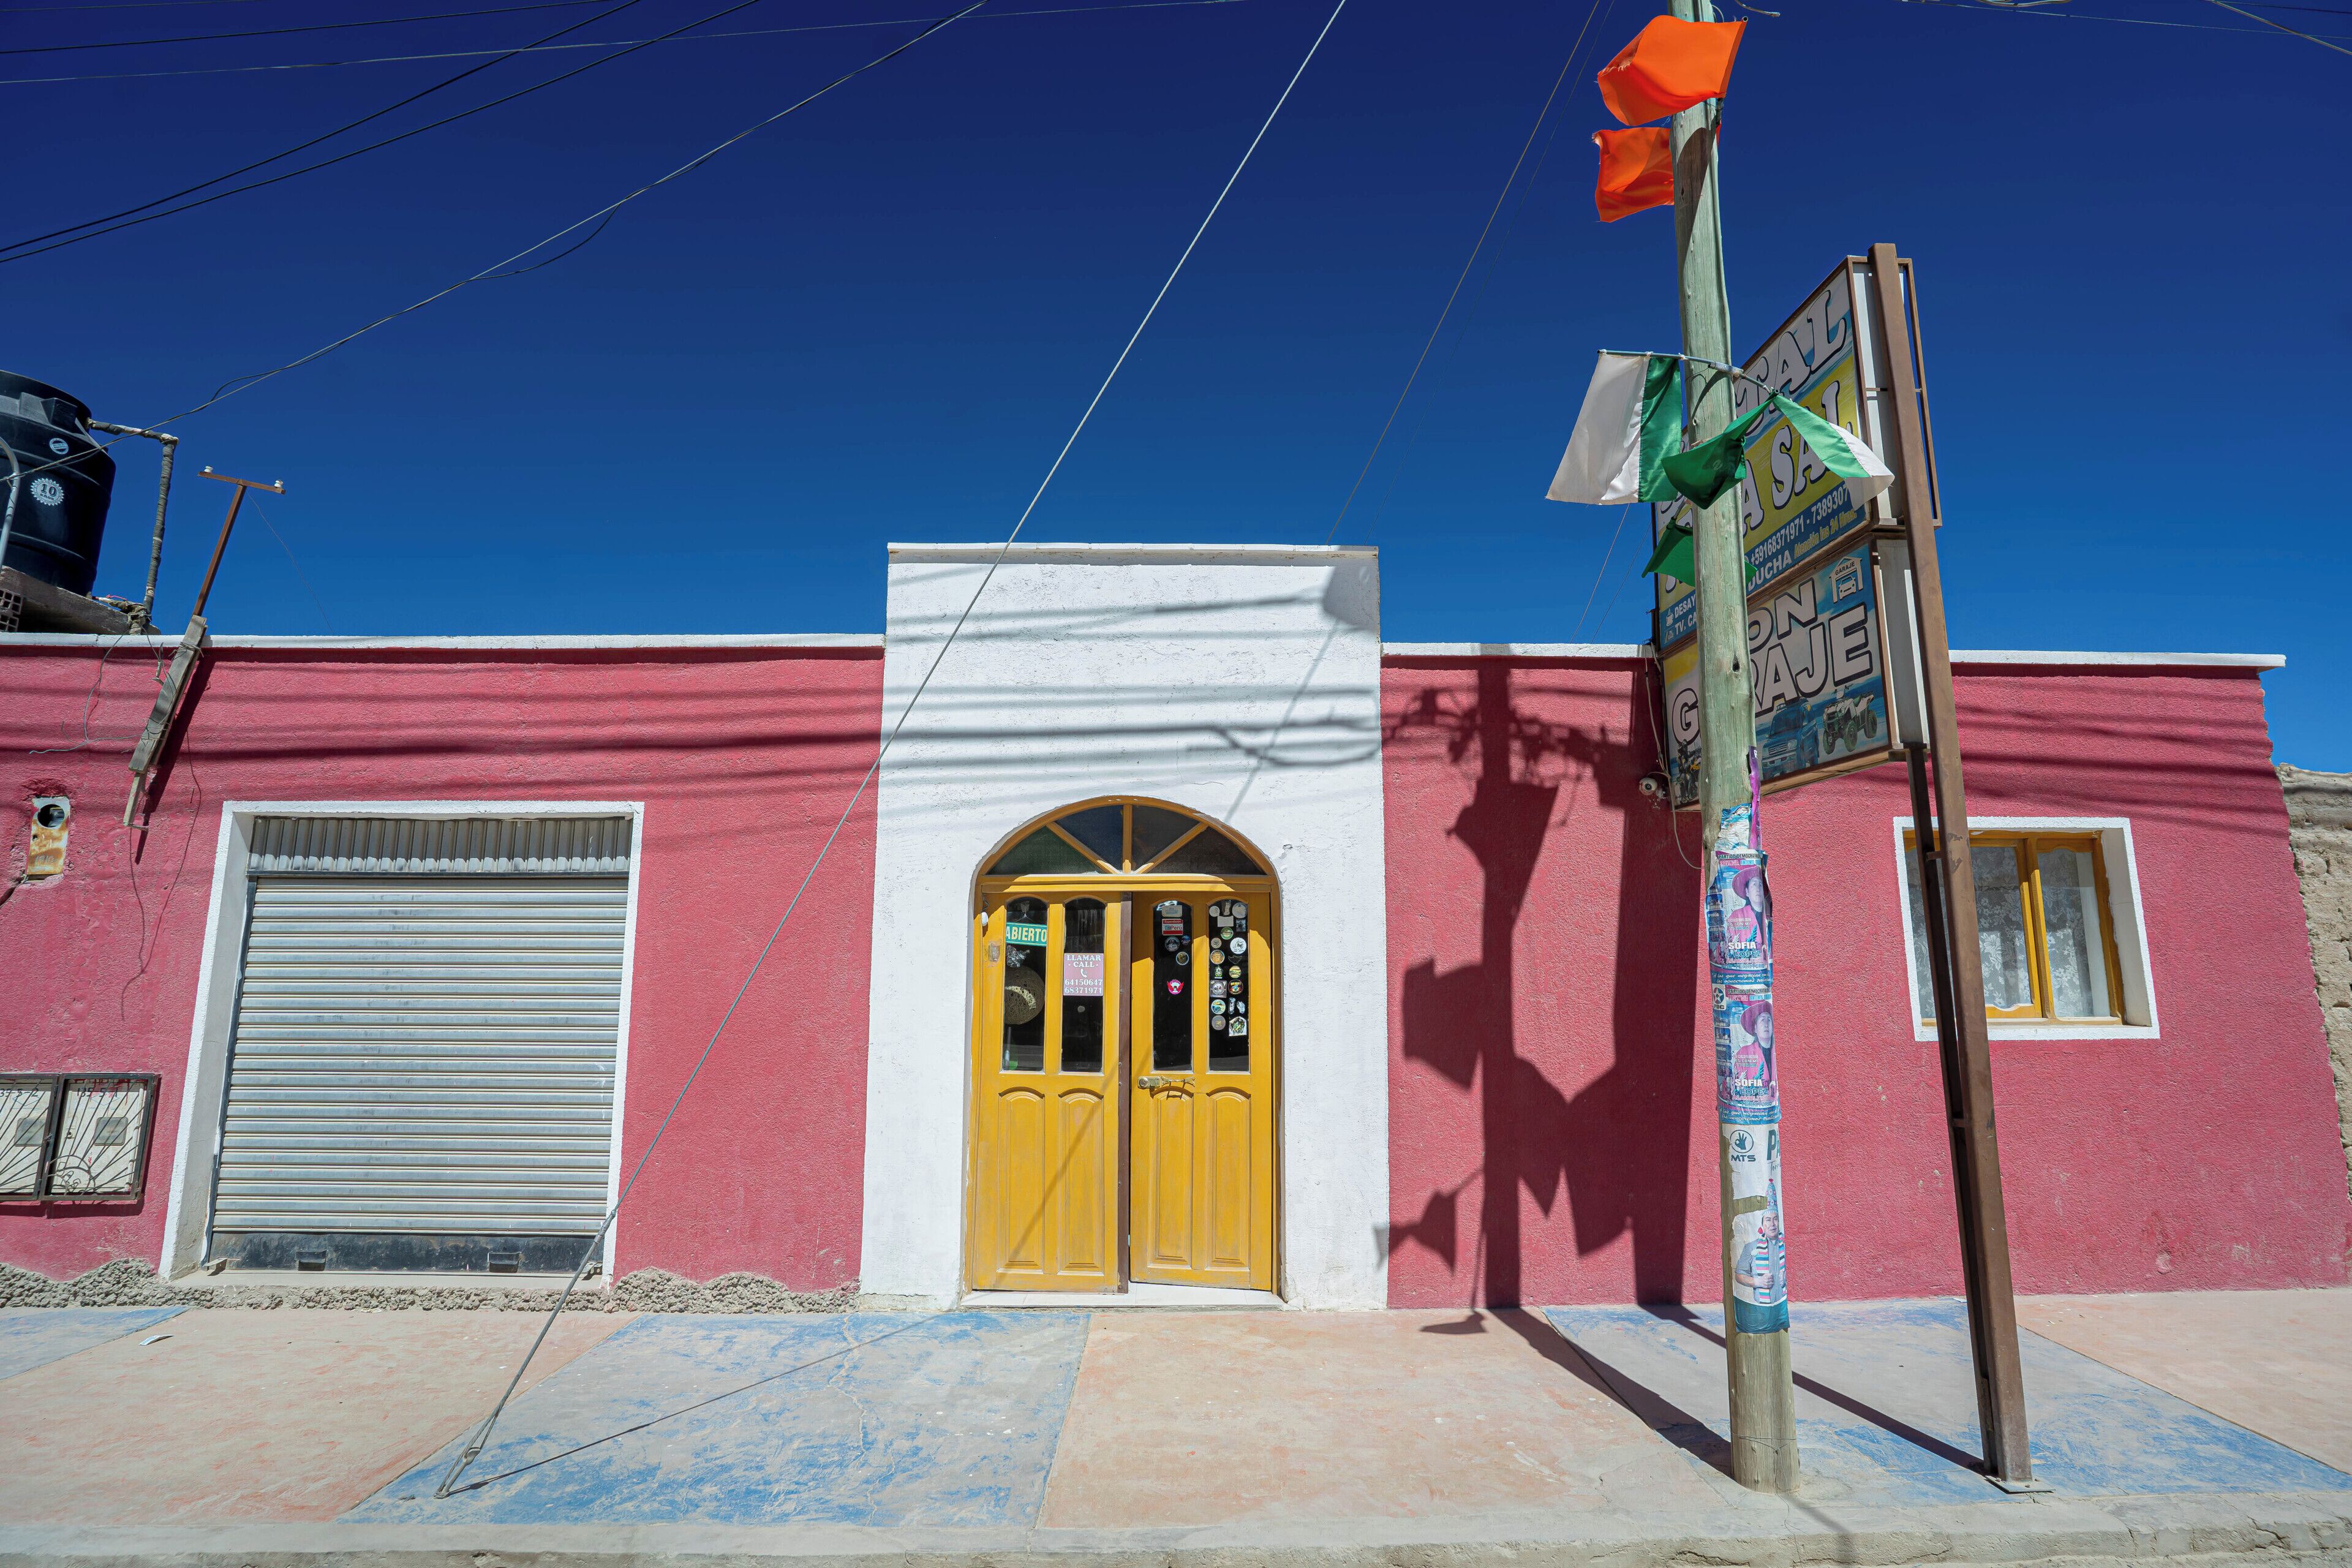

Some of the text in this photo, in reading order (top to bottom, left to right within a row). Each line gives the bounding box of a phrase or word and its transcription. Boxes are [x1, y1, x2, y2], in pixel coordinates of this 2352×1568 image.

[41, 483, 58, 497] 10
[1751, 514, 1804, 565] +59168371971
[1811, 484, 1848, 524] 7389307
[1835, 560, 1855, 576] GARAJE
[1675, 594, 1695, 619] DESAY
[1747, 577, 1818, 654] ON
[1006, 925, 1047, 942] ABIERTO
[1728, 941, 1756, 950] SOFIA
